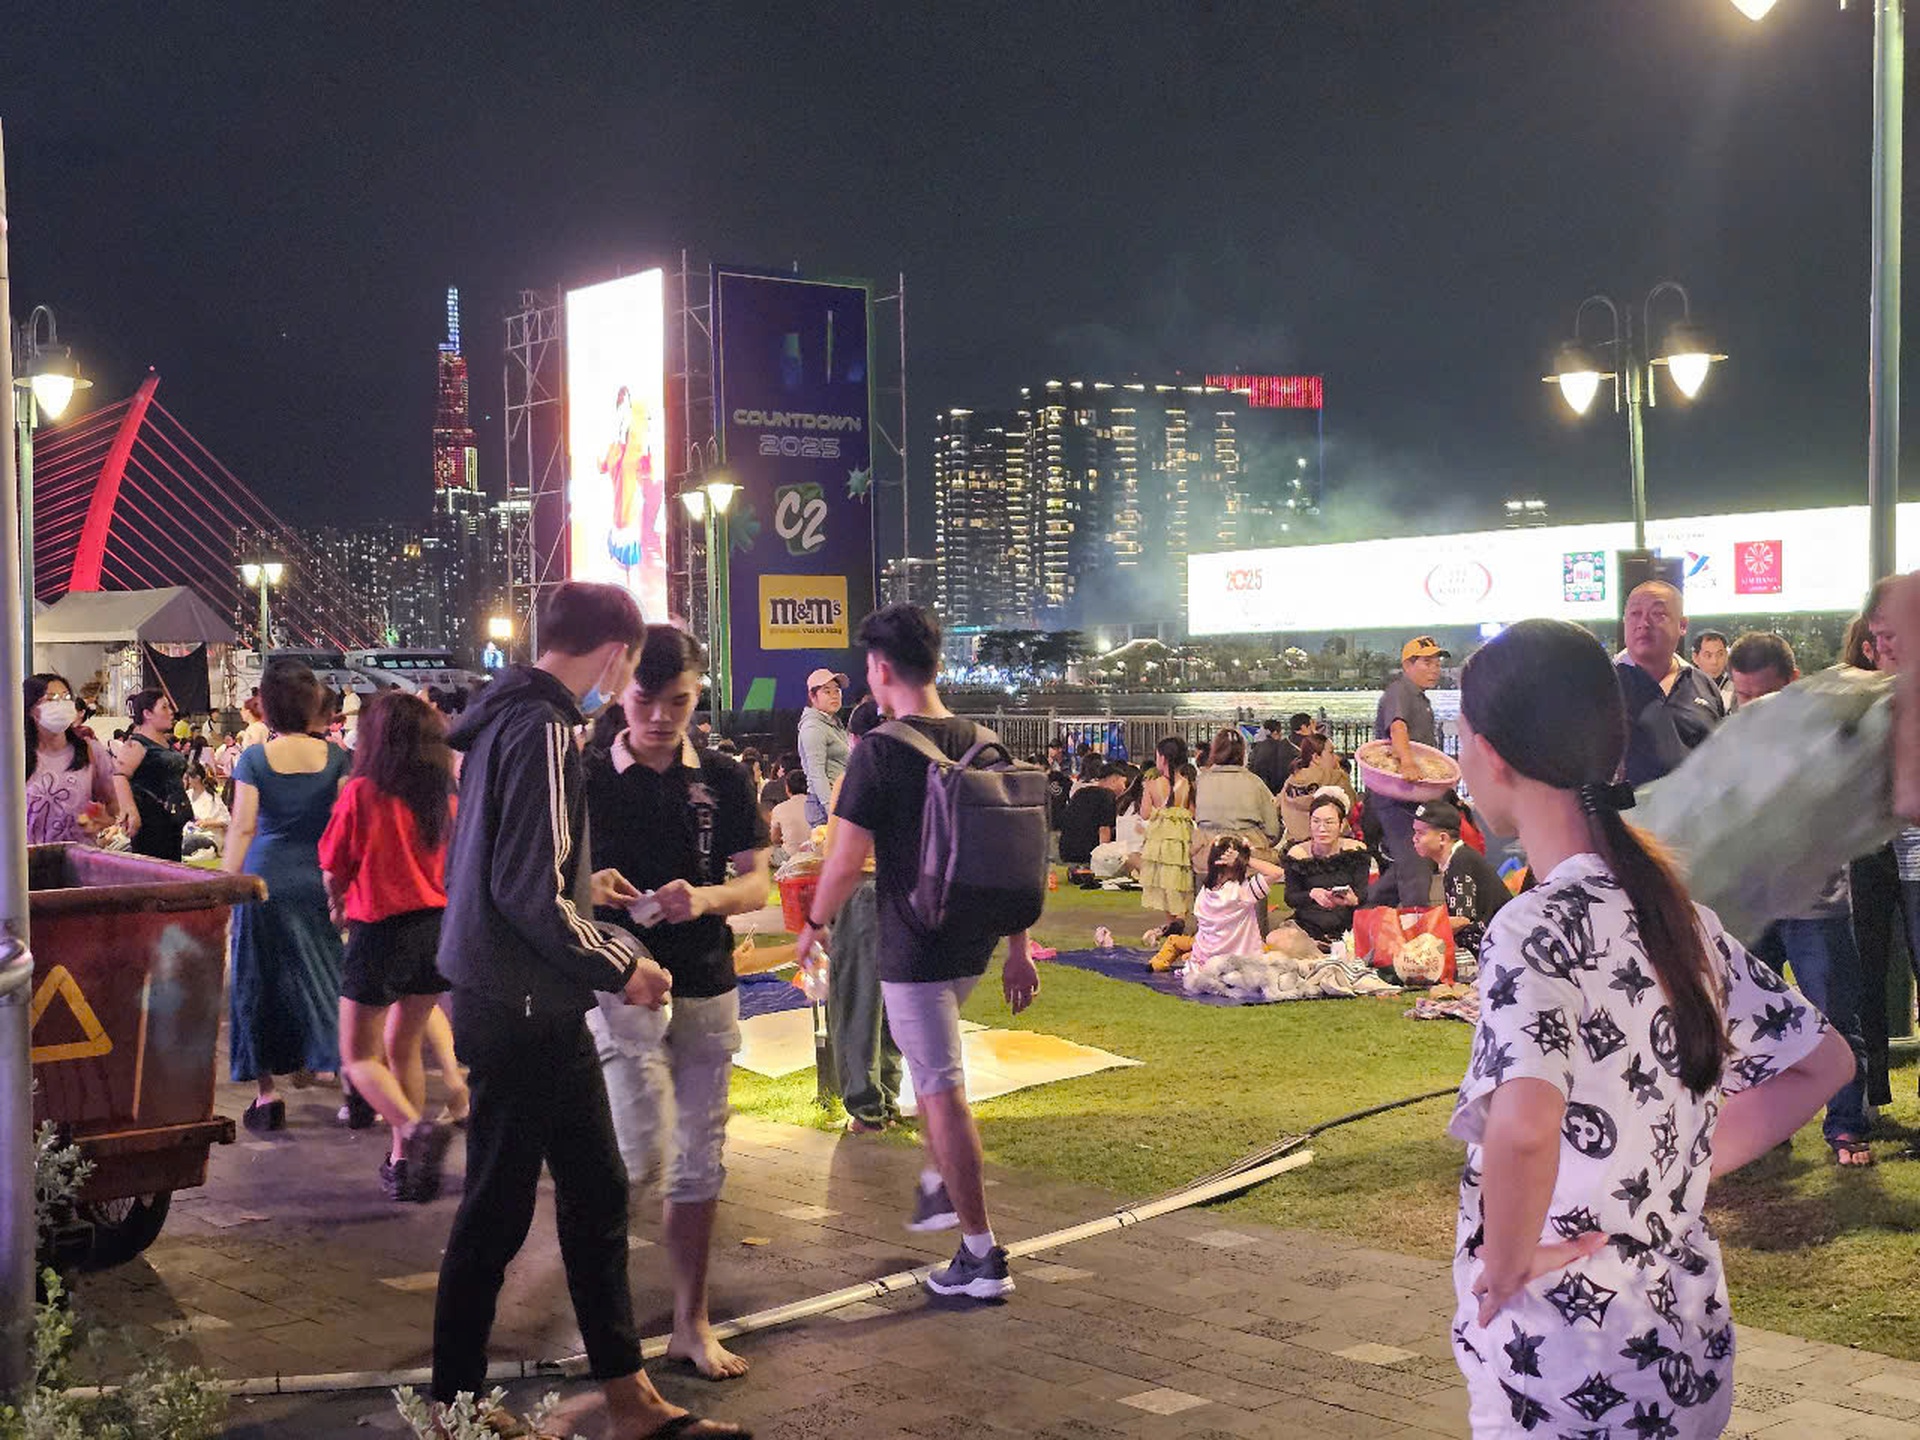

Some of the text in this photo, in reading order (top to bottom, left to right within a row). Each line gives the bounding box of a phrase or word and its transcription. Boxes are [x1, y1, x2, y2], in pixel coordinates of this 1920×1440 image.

[733, 409, 862, 432] COUNTDOWN
[759, 434, 841, 459] 2025
[775, 491, 828, 550] C2
[1226, 568, 1263, 592] 2025
